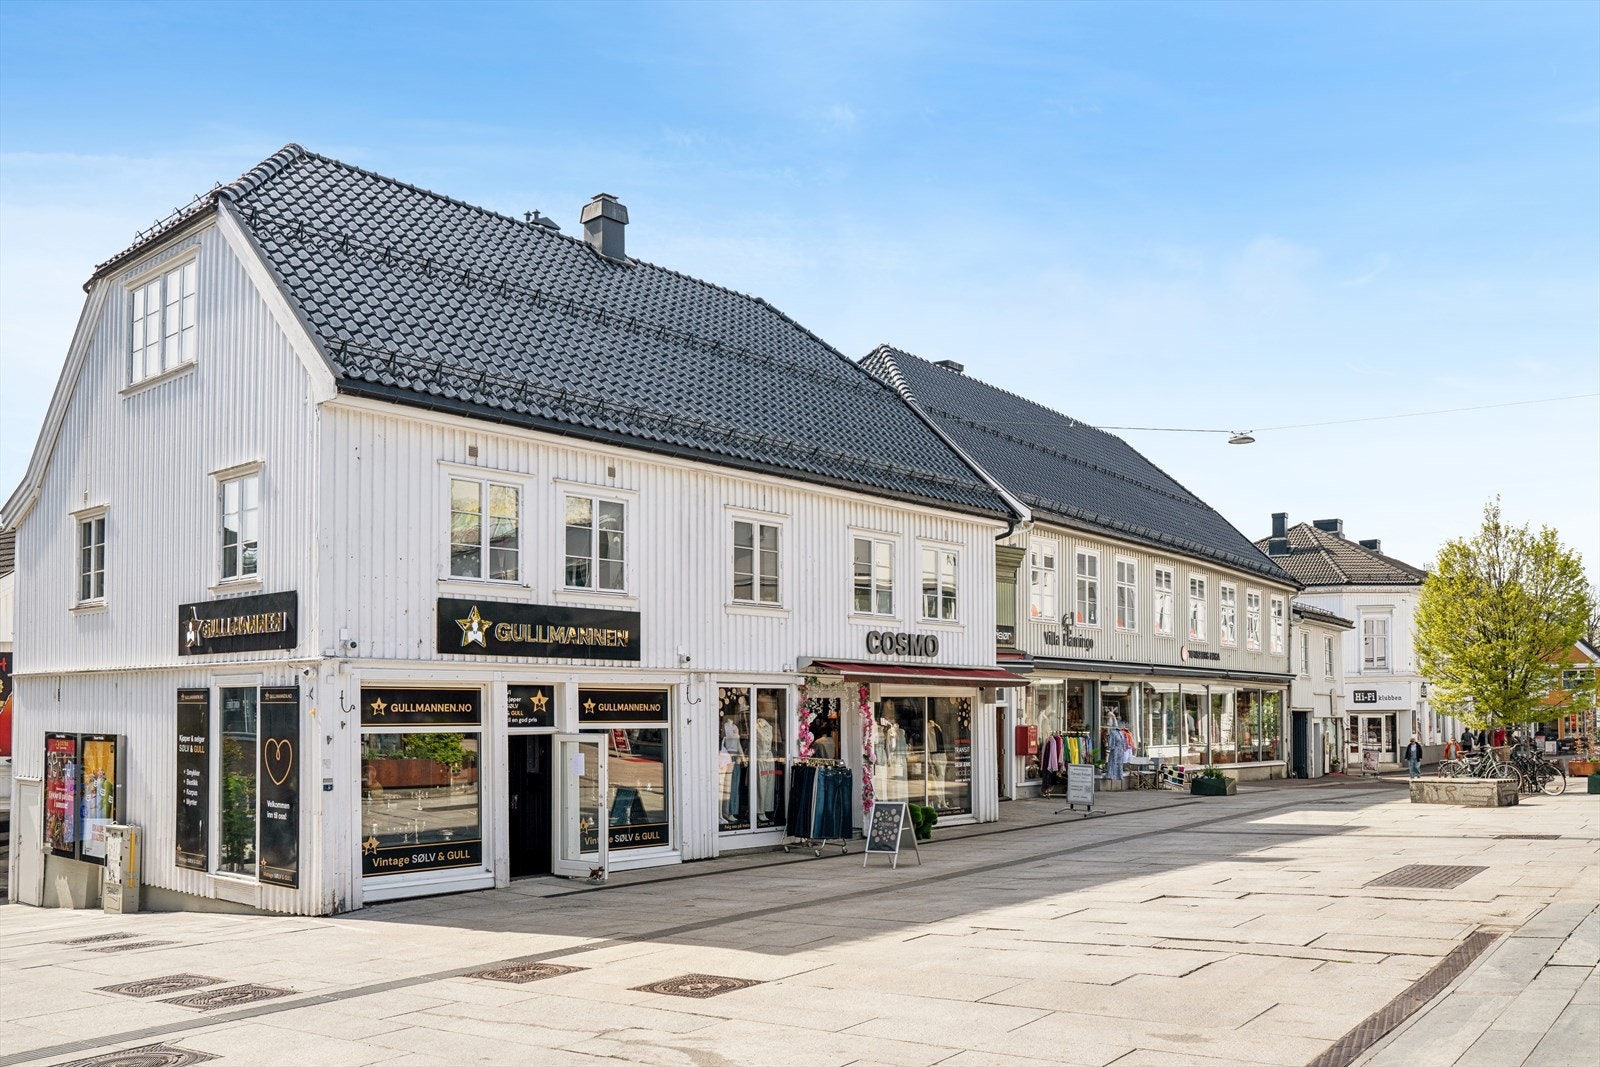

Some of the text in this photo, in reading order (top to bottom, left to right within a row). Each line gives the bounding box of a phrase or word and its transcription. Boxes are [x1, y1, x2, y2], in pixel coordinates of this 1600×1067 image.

[202, 612, 287, 639] GULLMANNEN
[495, 622, 630, 648] GULLMANNEN
[1044, 631, 1094, 652] Villa Flamingo
[866, 630, 939, 658] COSMO
[1355, 692, 1375, 701] Hi-Fi
[391, 704, 472, 712] GULLMANNEN.NO
[598, 703, 661, 712] GULLMANNEN.NO
[194, 745, 205, 753] GULL
[267, 800, 290, 809] Velkommen
[584, 836, 613, 845] Vinte
[615, 834, 633, 843] SØLV
[642, 831, 660, 840] GULL
[372, 850, 470, 867] Vintage SØLV & GULL
